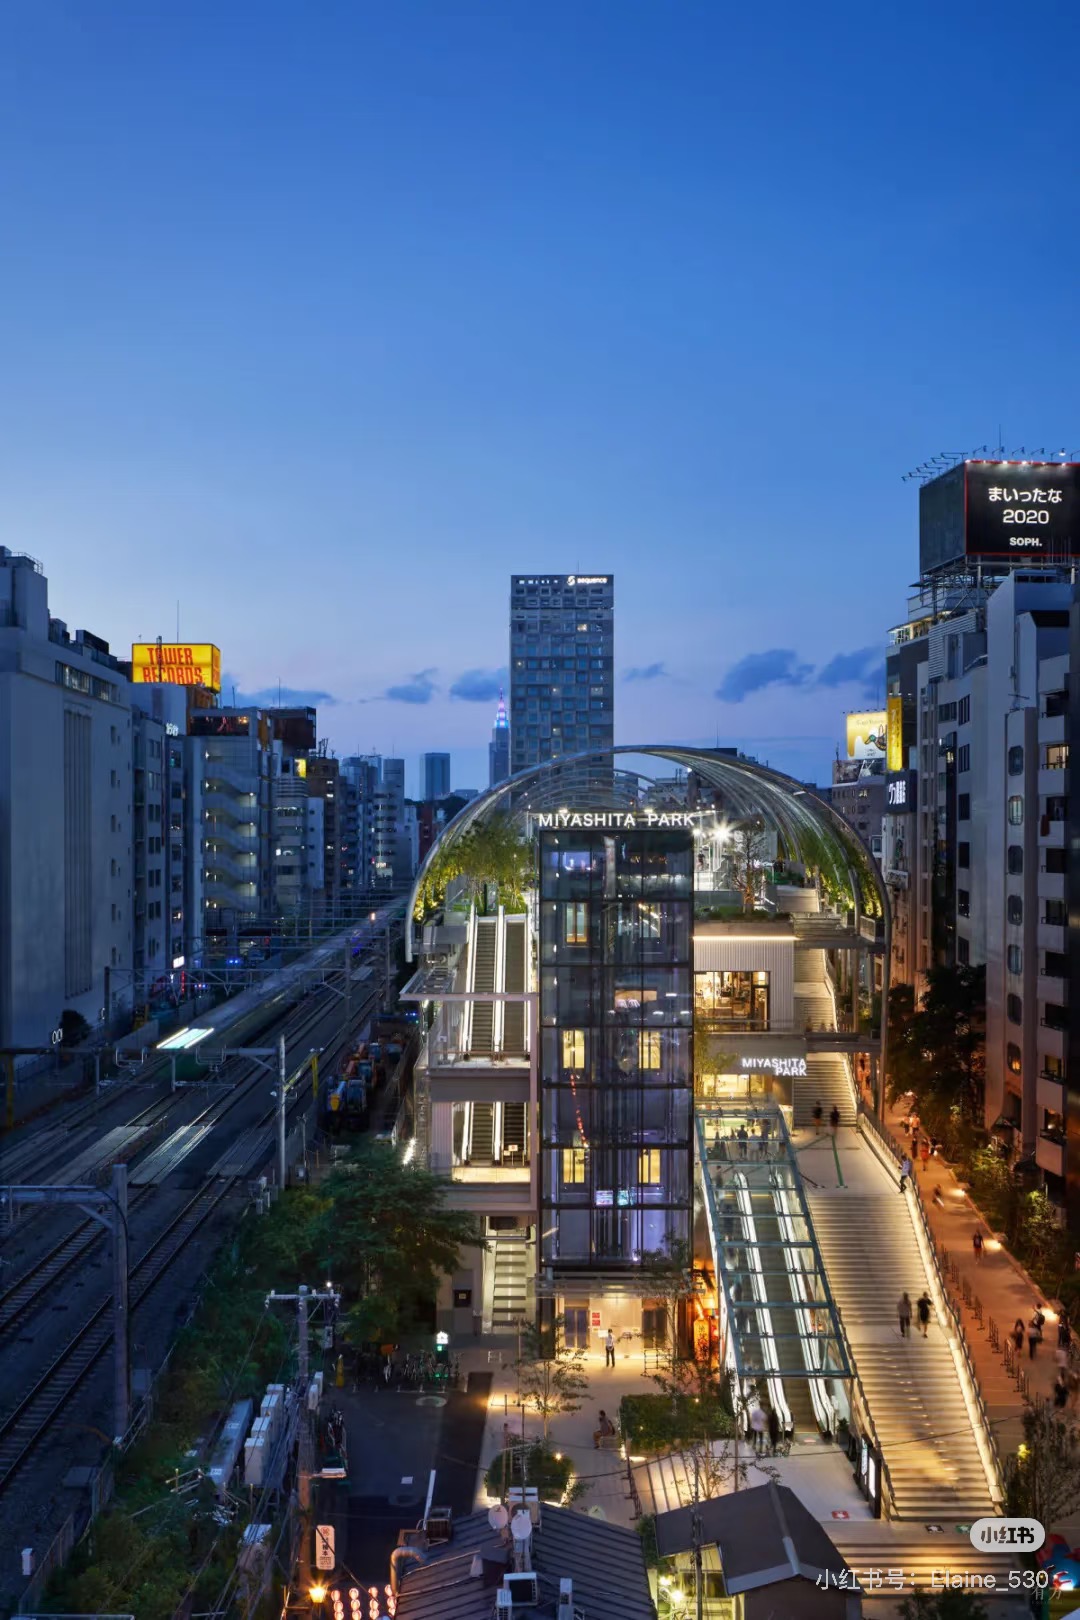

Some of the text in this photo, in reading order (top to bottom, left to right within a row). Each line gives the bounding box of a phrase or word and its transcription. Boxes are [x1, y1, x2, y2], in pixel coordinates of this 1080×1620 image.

[988, 487, 1062, 503] まいったな
[1003, 509, 1050, 524] 2020
[1009, 537, 1043, 547] SOPH.
[147, 648, 194, 665] TOWER
[143, 667, 202, 683] RECORDS
[538, 813, 695, 827] MIYASHITA PARK
[742, 1058, 807, 1068] MIYASHITA
[775, 1066, 807, 1076] PARK
